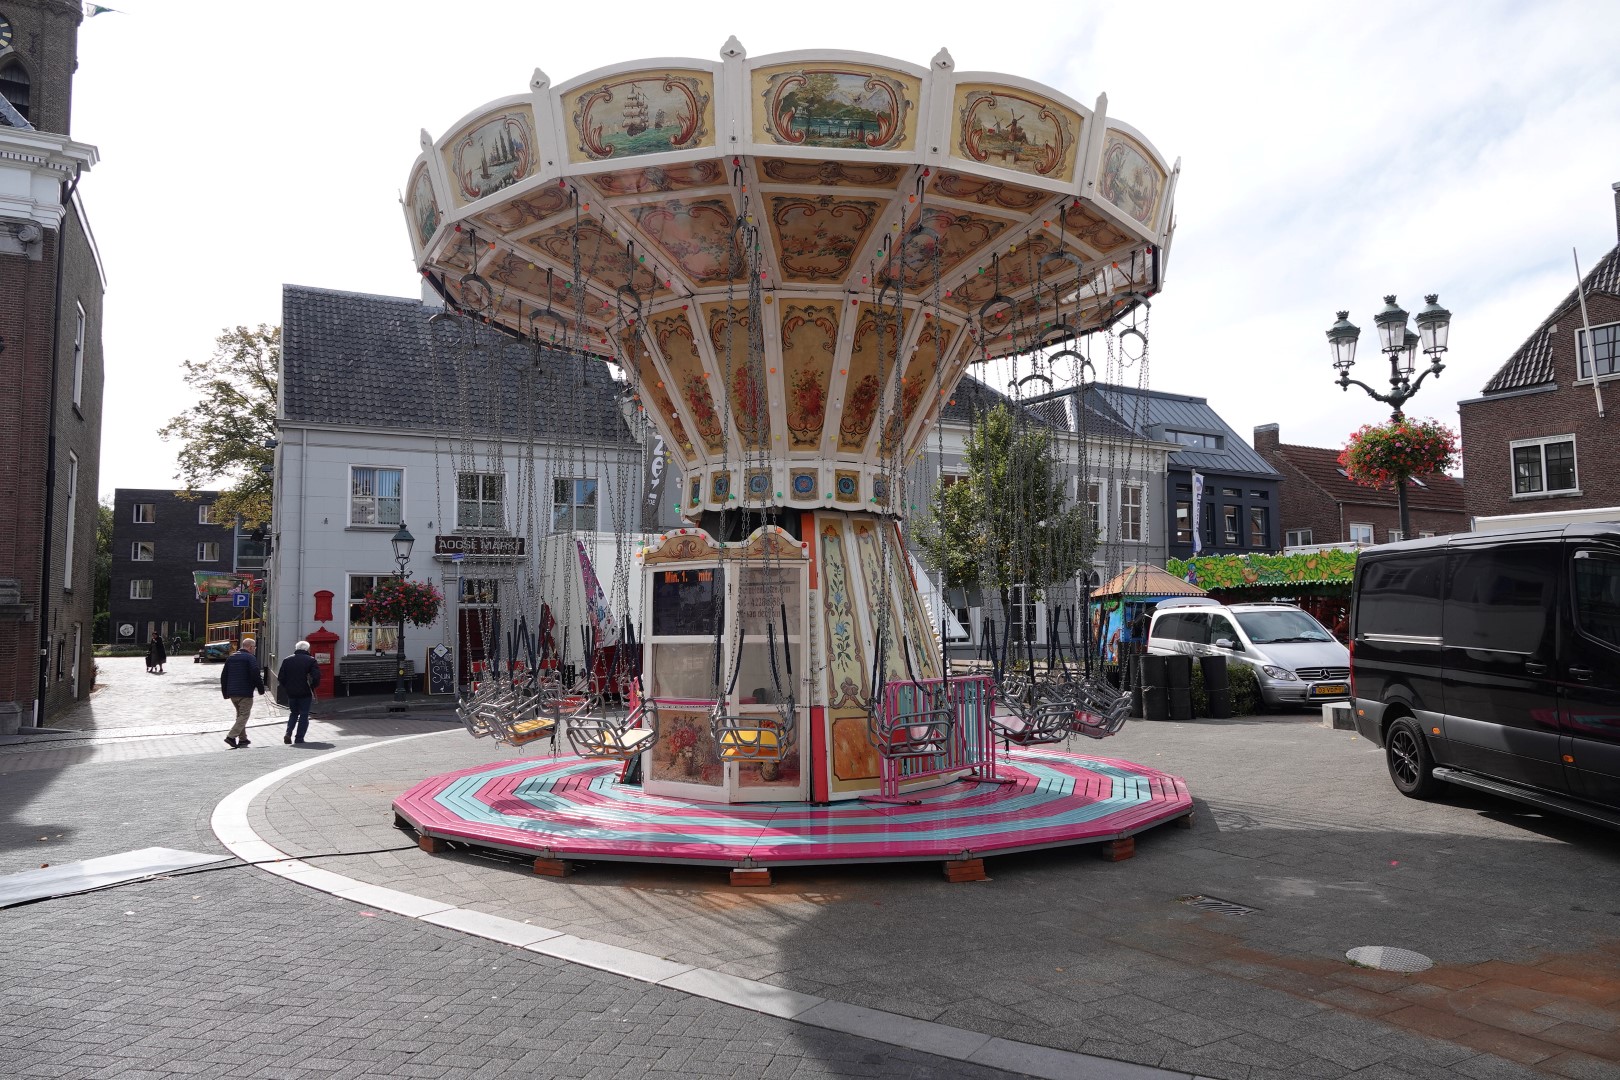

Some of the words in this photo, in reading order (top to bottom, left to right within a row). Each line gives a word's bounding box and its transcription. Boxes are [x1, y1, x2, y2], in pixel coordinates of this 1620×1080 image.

[480, 541, 522, 551] MARKT
[664, 571, 679, 583] Min.
[698, 570, 713, 582] mtr.
[236, 595, 246, 605] P
